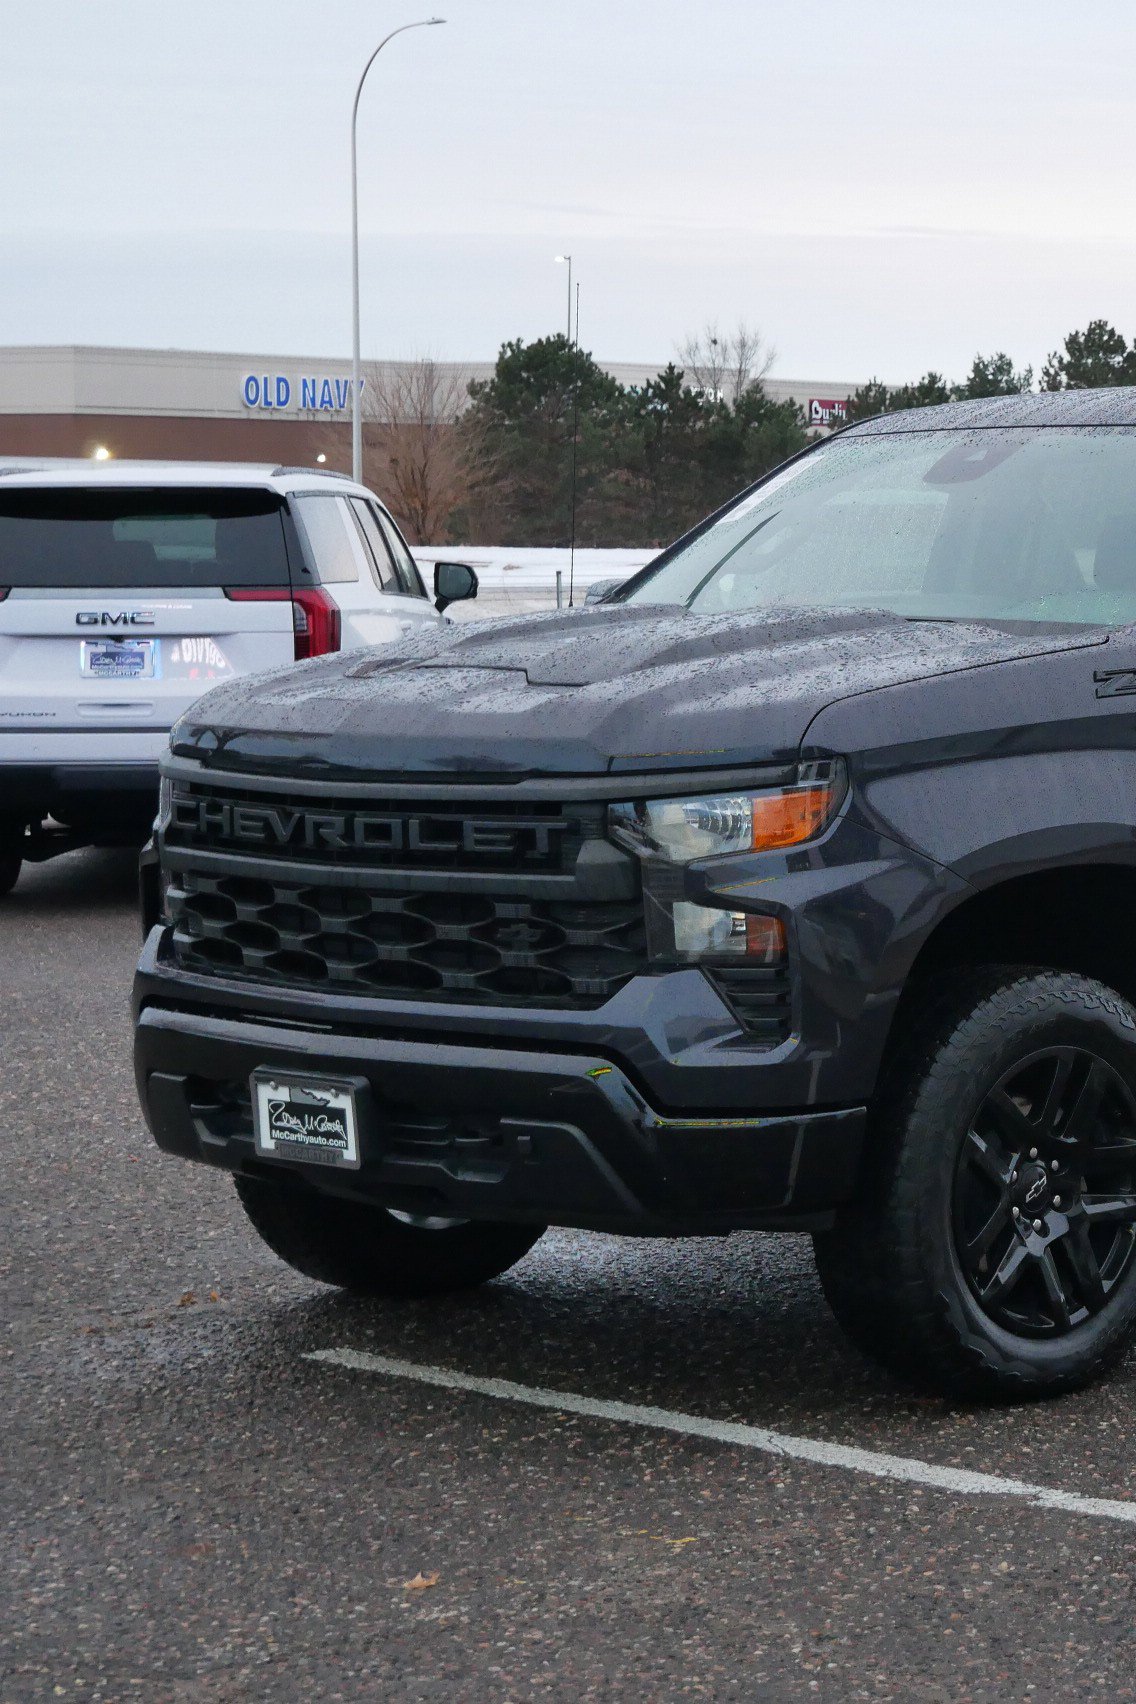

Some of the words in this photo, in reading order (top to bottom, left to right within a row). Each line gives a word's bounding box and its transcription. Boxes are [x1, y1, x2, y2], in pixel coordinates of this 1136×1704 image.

[244, 375, 291, 407] OLD
[301, 378, 364, 409] NAV
[76, 612, 155, 625] GMC
[172, 800, 569, 858] CHEVROLET
[272, 1130, 346, 1147] McCarthyauto.com
